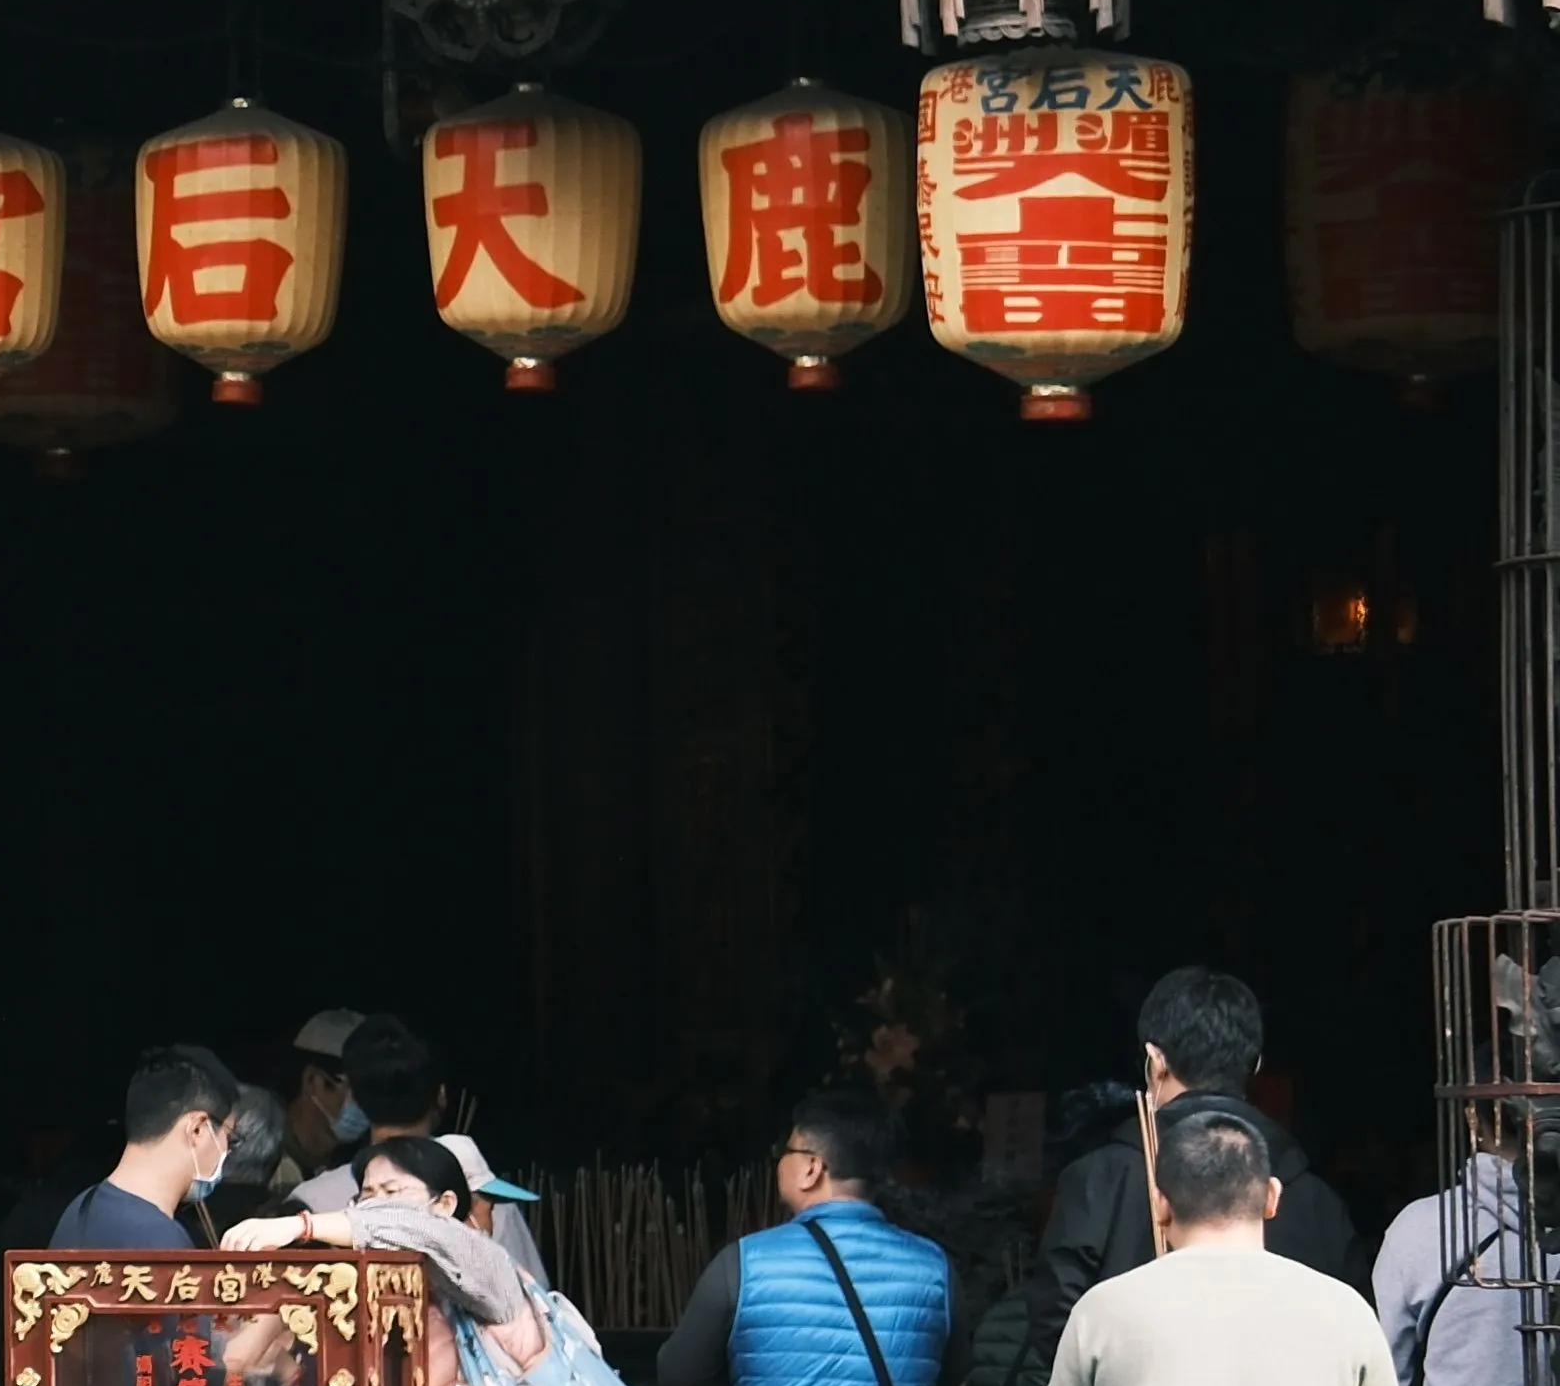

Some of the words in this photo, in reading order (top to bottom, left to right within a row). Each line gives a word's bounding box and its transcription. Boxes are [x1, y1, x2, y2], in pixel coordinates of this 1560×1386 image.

[976, 63, 1152, 112] 天后宮
[144, 134, 294, 325] 后
[432, 118, 586, 310] 天
[719, 112, 883, 307] 鹿
[118, 1264, 248, 1304] 天后宮
